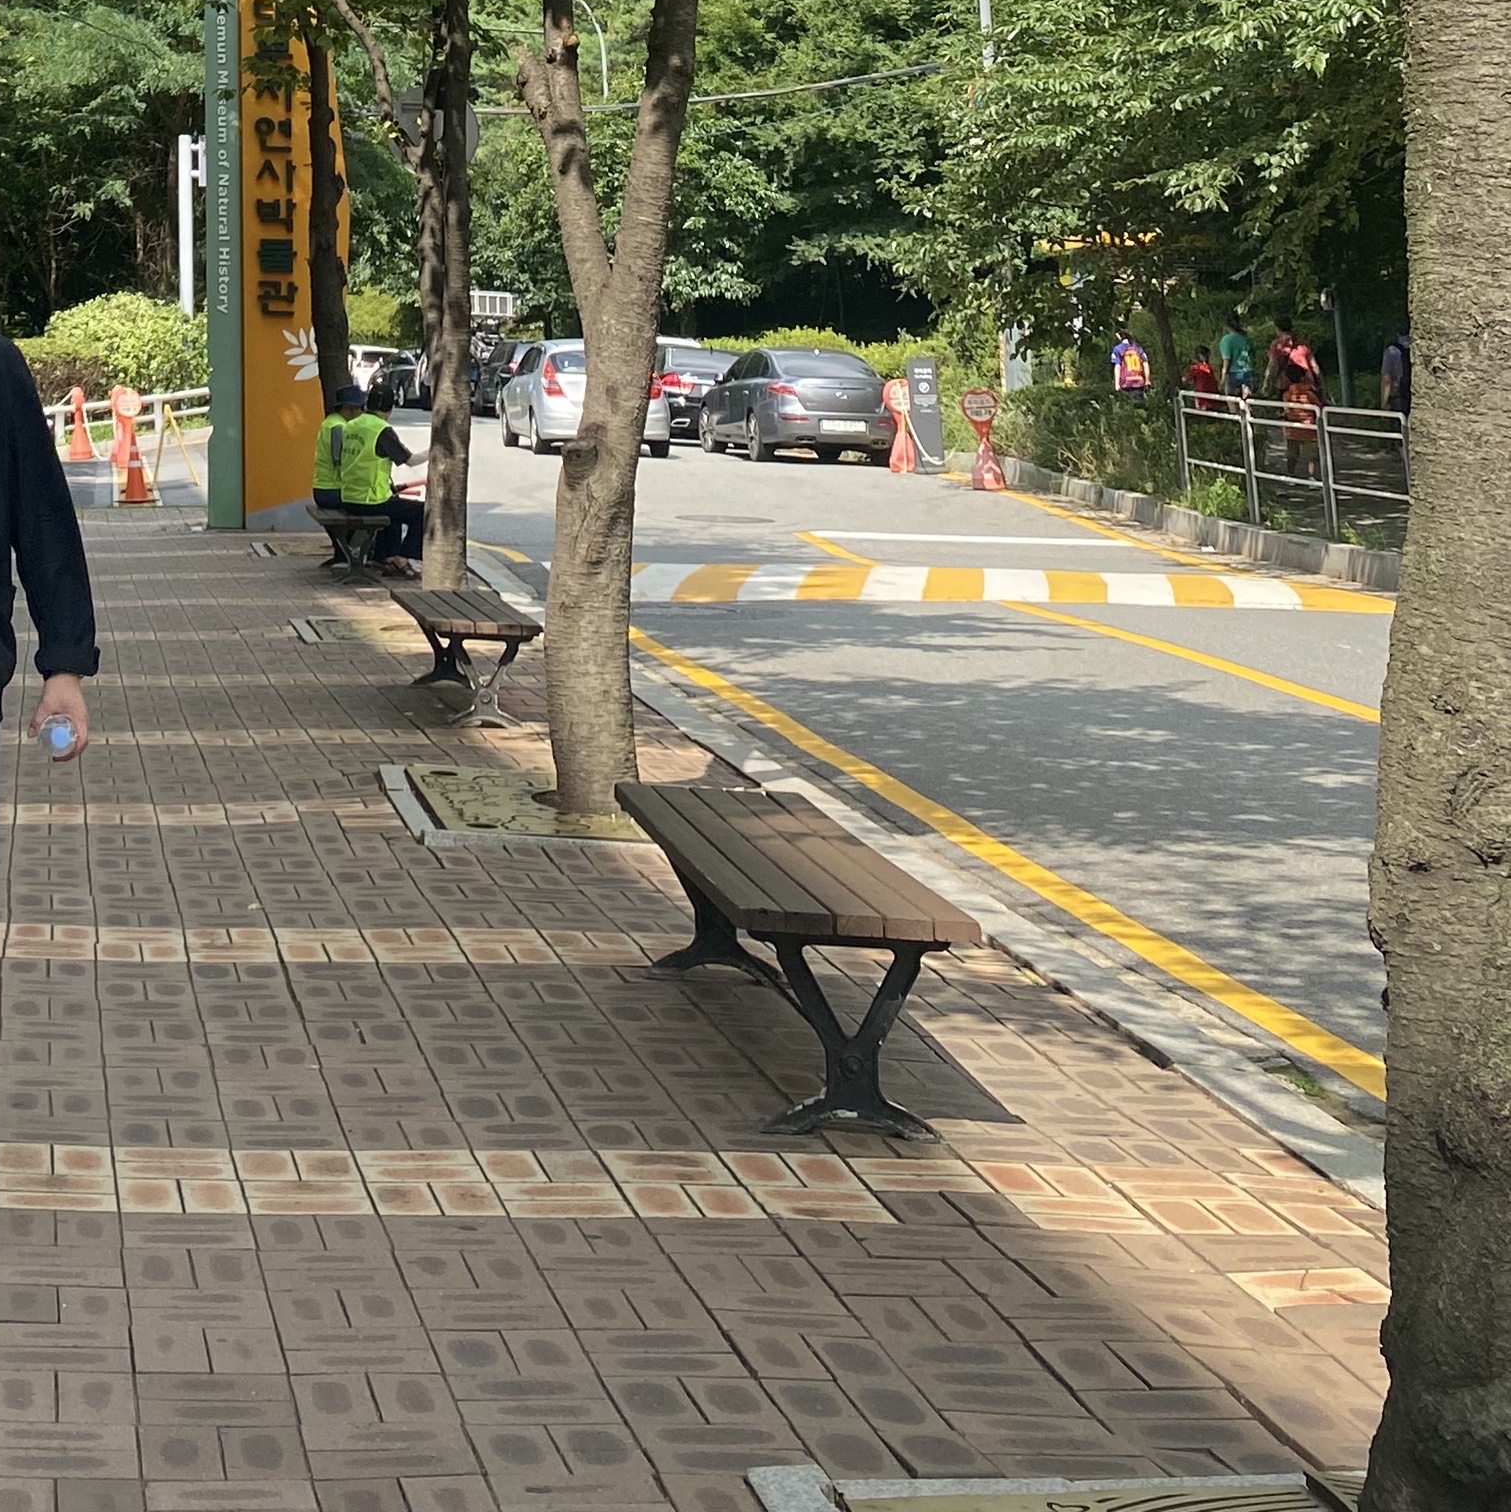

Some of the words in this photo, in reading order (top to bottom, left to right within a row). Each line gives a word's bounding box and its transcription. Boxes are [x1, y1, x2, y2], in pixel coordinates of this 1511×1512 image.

[217, 153, 230, 169] of
[217, 173, 230, 241] Natural
[217, 247, 231, 314] History
